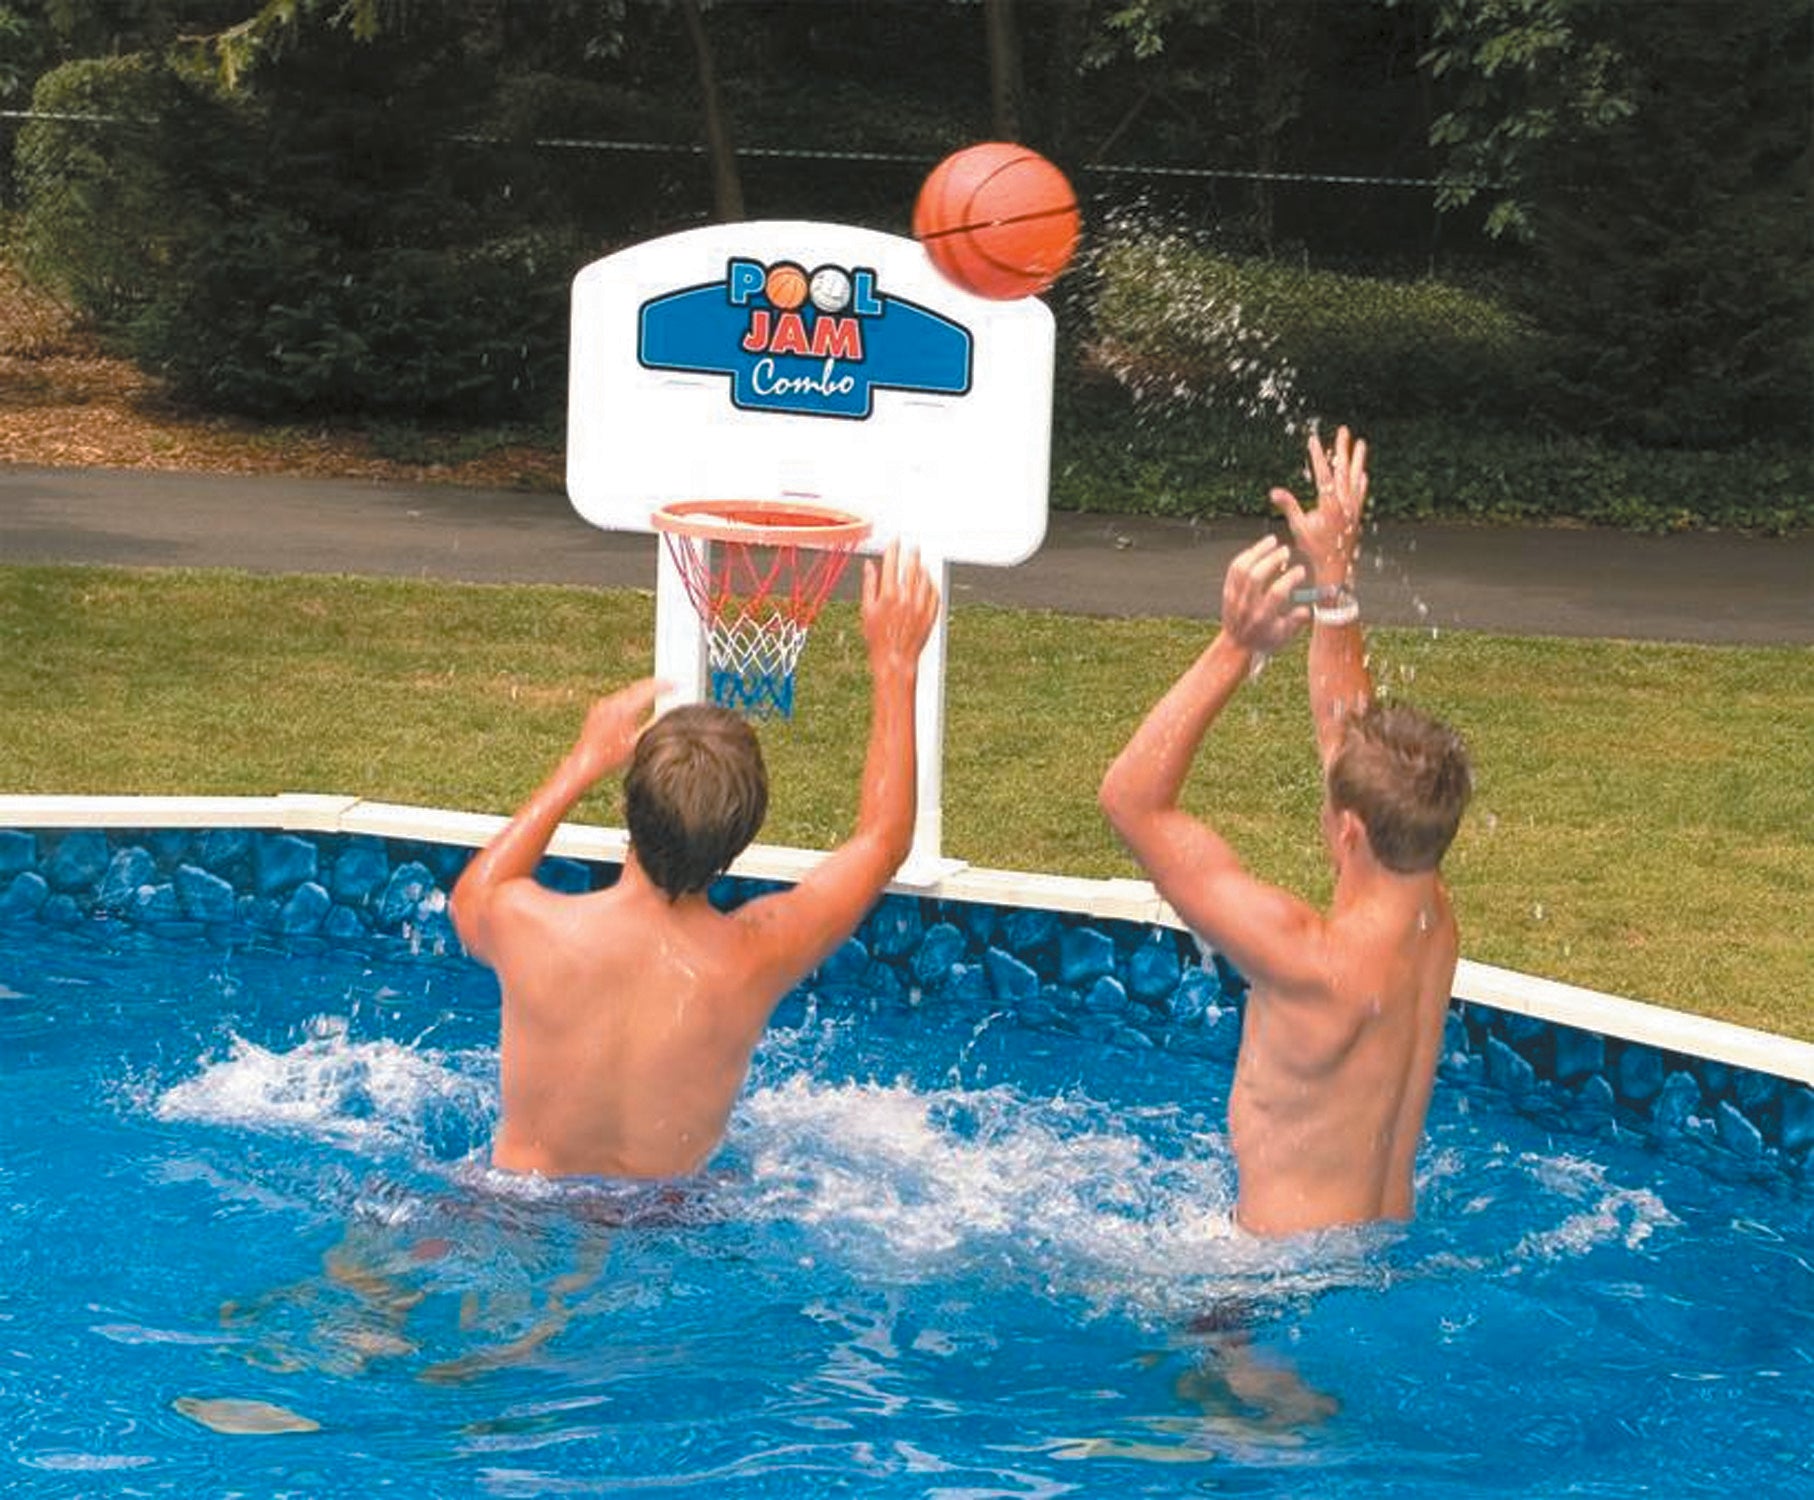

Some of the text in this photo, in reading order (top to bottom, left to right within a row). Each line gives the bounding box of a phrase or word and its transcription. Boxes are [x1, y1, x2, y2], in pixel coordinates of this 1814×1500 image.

[731, 262, 883, 315] POOL
[743, 311, 862, 359] JAM
[752, 358, 855, 396] Combo
